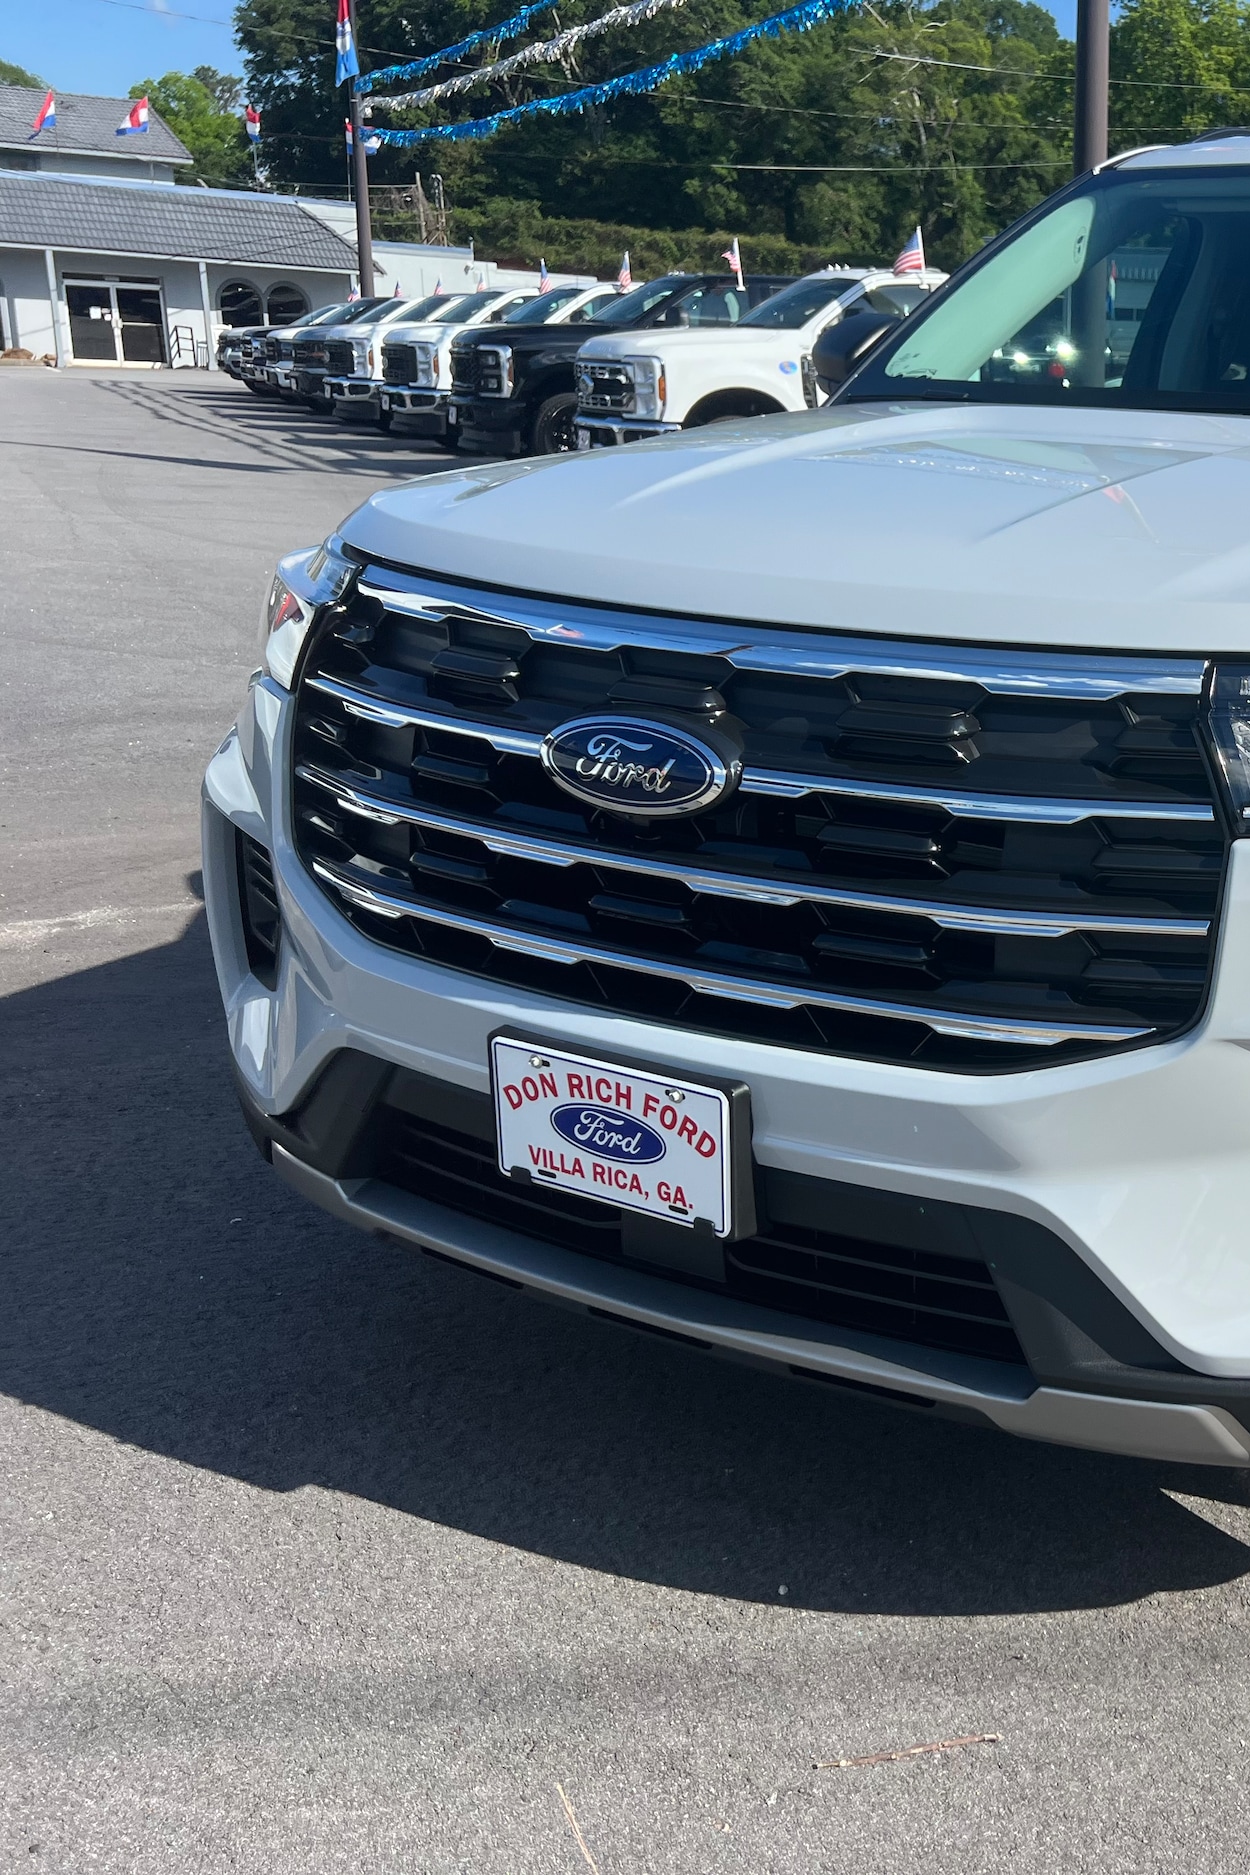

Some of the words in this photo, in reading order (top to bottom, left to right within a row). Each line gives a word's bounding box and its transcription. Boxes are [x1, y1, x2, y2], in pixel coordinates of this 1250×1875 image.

[576, 734, 676, 793] Ford
[503, 1073, 557, 1110] DON
[567, 1073, 632, 1110] RICH
[644, 1094, 717, 1158] FORD
[574, 1110, 642, 1155] Ford
[528, 1145, 585, 1178] VILLA
[592, 1162, 649, 1200] RICA,
[657, 1181, 694, 1209] GA.
